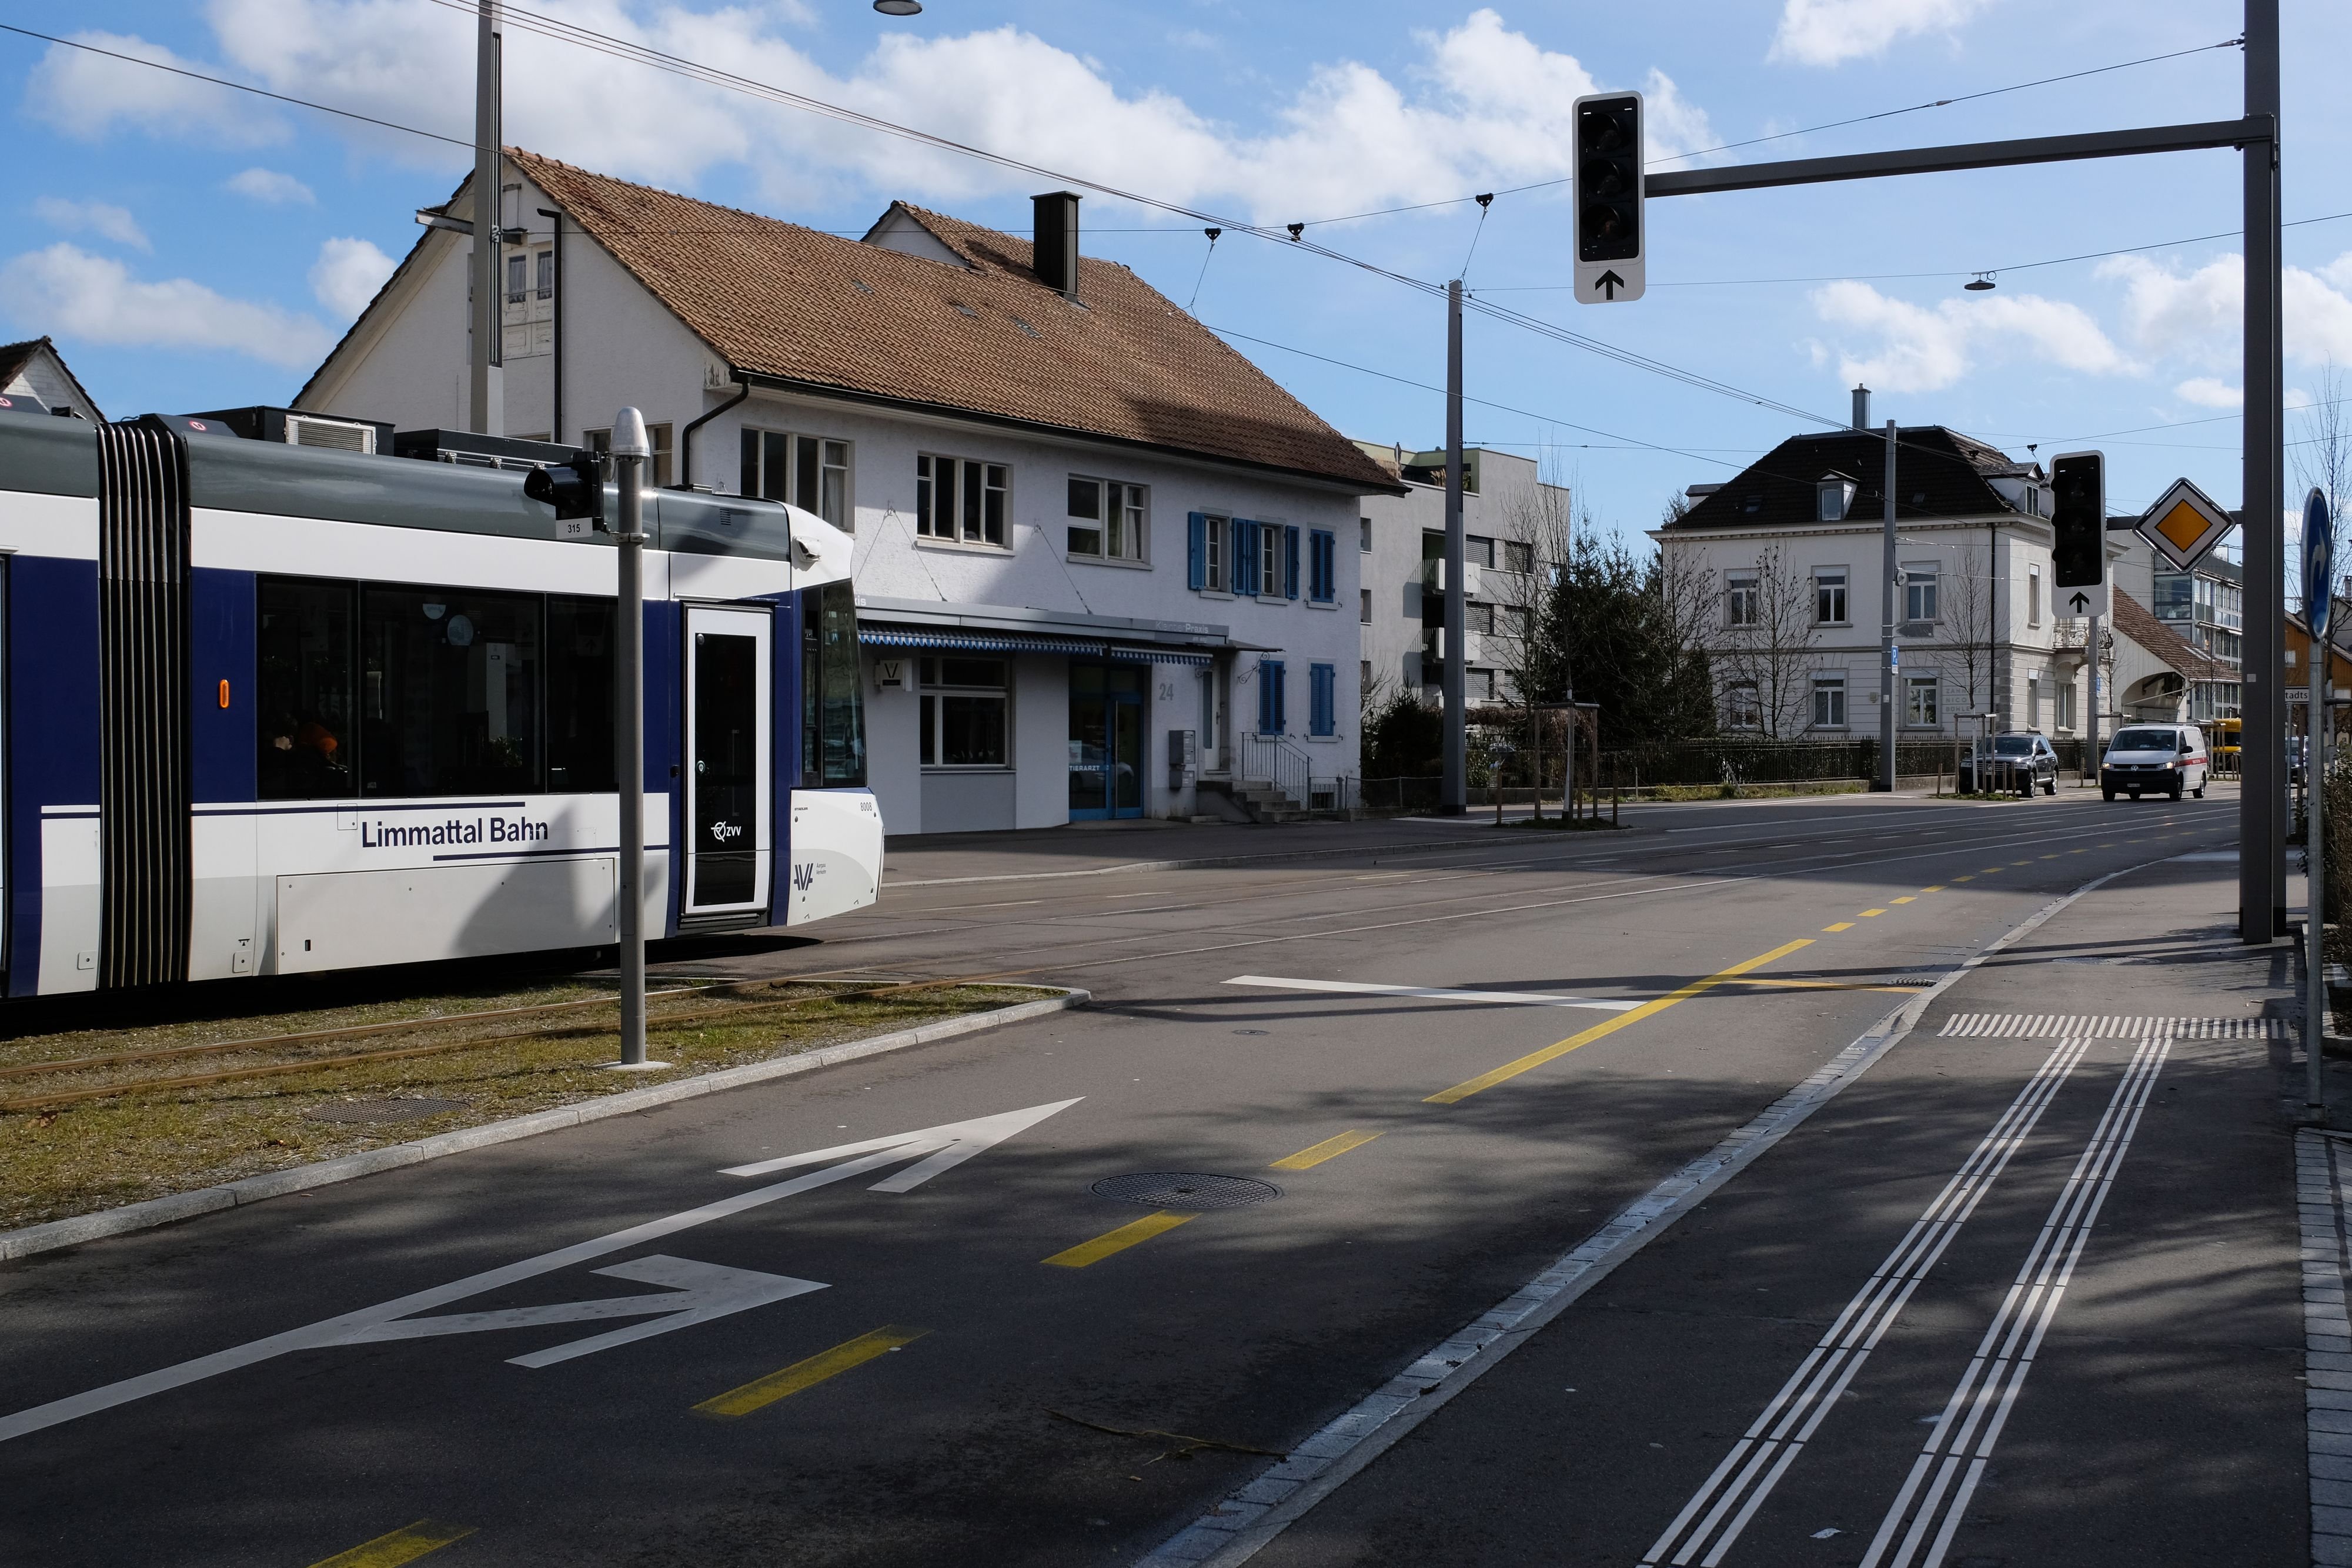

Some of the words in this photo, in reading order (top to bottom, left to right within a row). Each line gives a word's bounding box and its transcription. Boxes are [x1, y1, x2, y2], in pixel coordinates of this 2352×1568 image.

[567, 524, 580, 533] 315
[1159, 683, 1174, 701] 24
[860, 802, 873, 811] 8008
[362, 818, 482, 847] Limmattal
[490, 817, 548, 842] Bahn
[726, 826, 741, 836] ZVV
